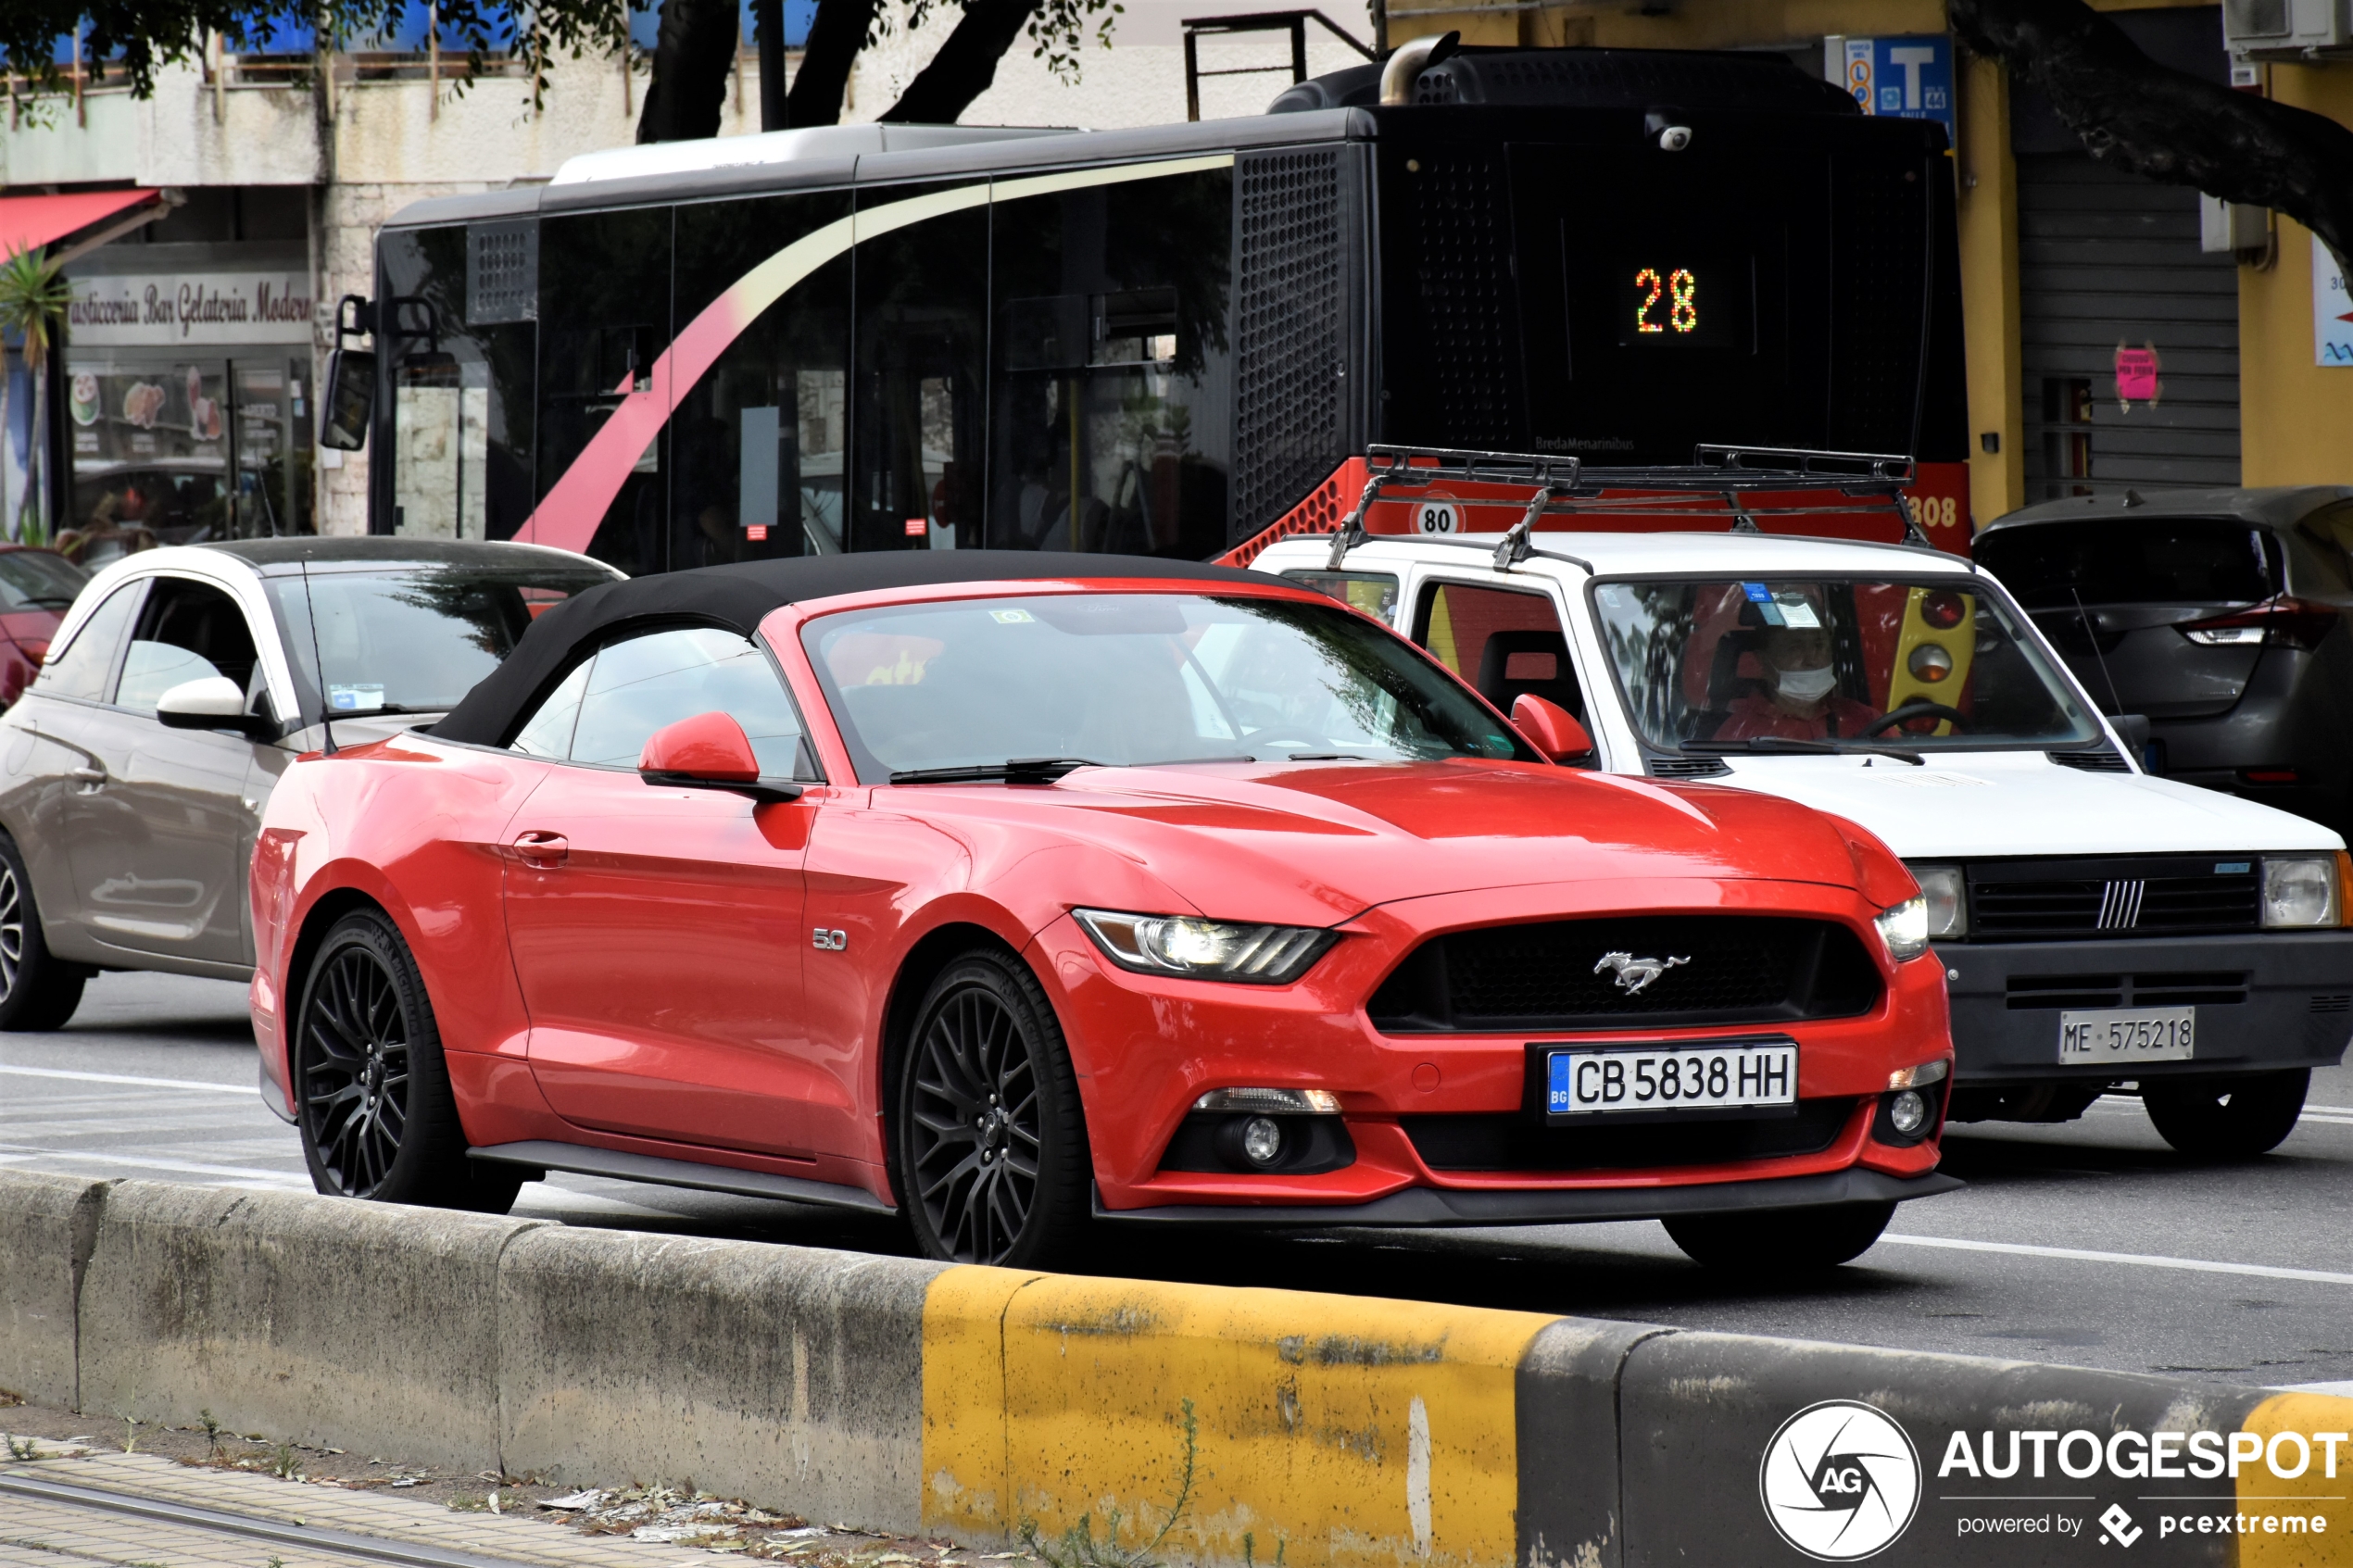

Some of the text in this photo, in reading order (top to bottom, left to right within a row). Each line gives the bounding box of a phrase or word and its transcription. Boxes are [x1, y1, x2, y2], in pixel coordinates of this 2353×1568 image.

[1891, 46, 1933, 109] T
[71, 291, 138, 324] asticceria
[144, 282, 174, 325] Bar
[252, 281, 312, 324] Modern
[1636, 269, 1696, 332] 28
[1424, 508, 1450, 533] 80
[2063, 1019, 2192, 1052] ME 575218
[1551, 1091, 1567, 1104] BG
[1577, 1054, 1789, 1103] CB 5838 HH
